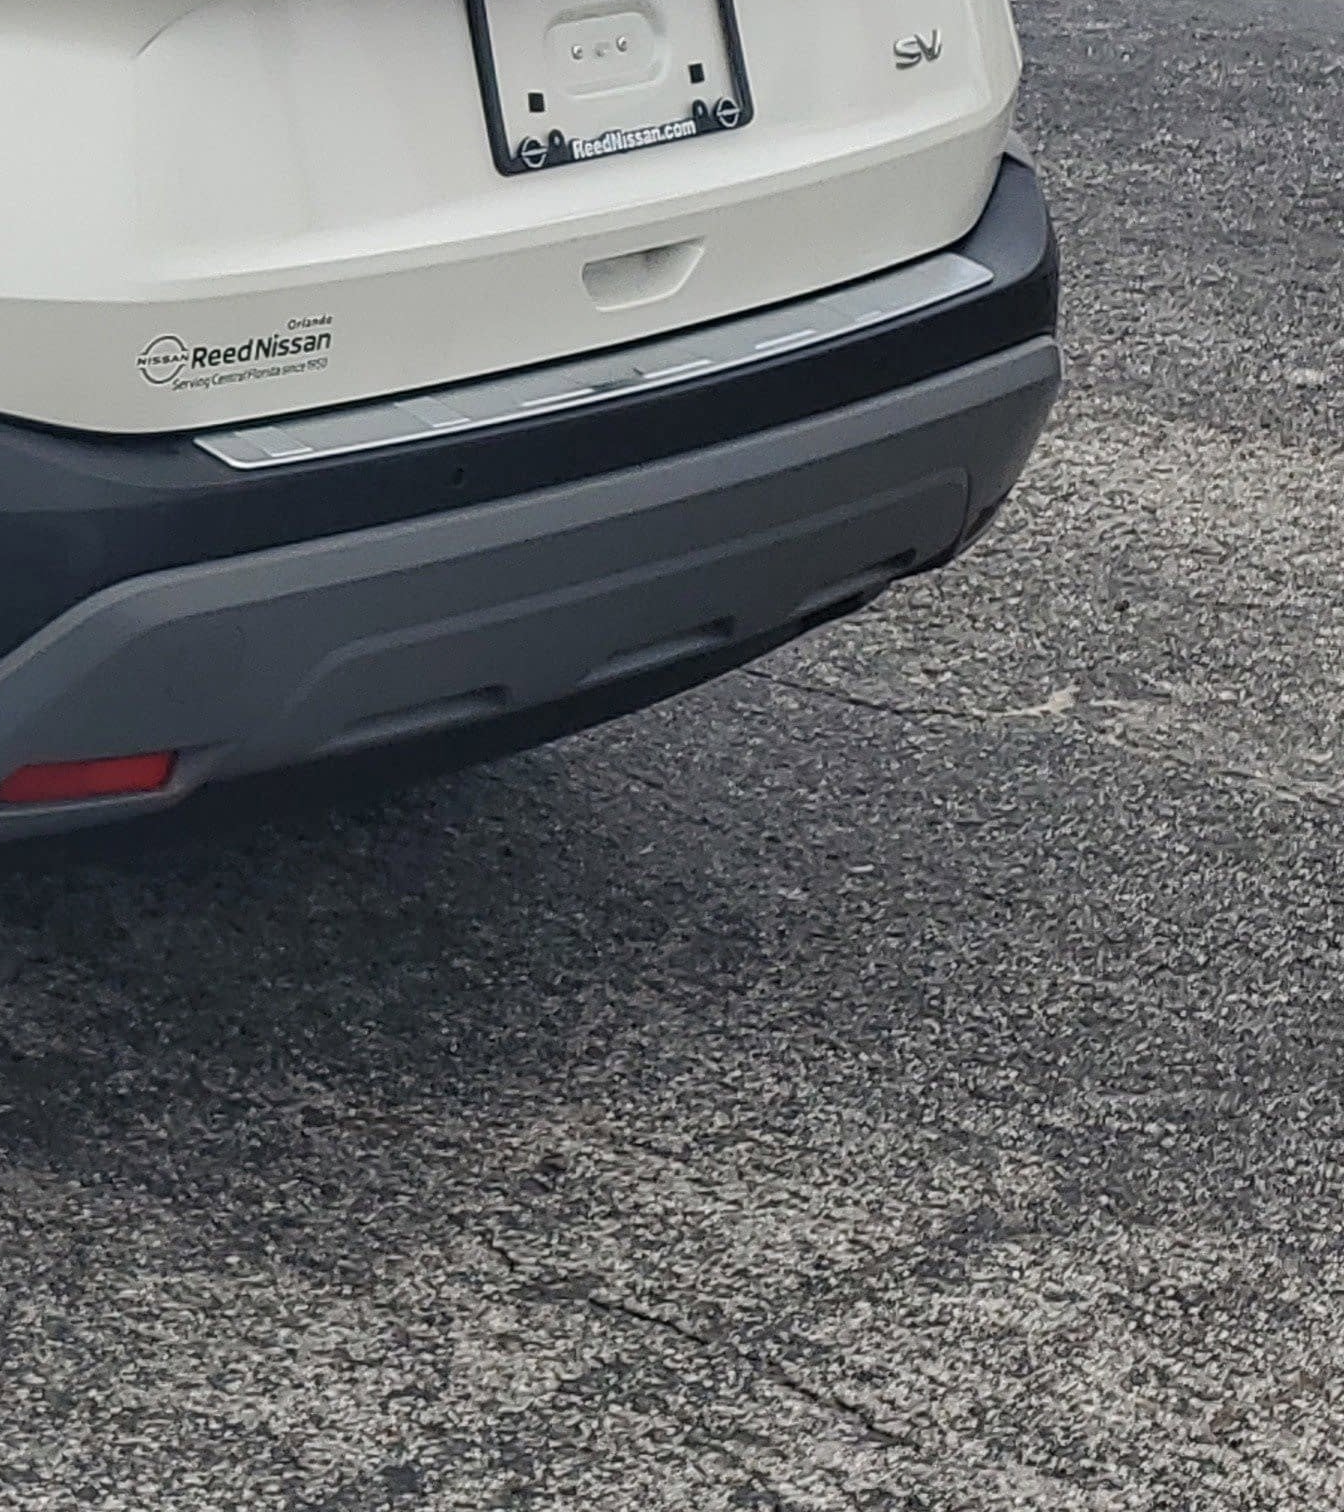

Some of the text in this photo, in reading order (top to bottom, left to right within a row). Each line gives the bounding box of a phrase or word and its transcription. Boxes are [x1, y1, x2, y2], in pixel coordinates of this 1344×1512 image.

[893, 29, 942, 70] SV
[572, 119, 697, 160] ReedNissan.com
[287, 315, 333, 330] Orlando
[136, 354, 189, 366] NISSAN
[172, 374, 210, 391] Serving
